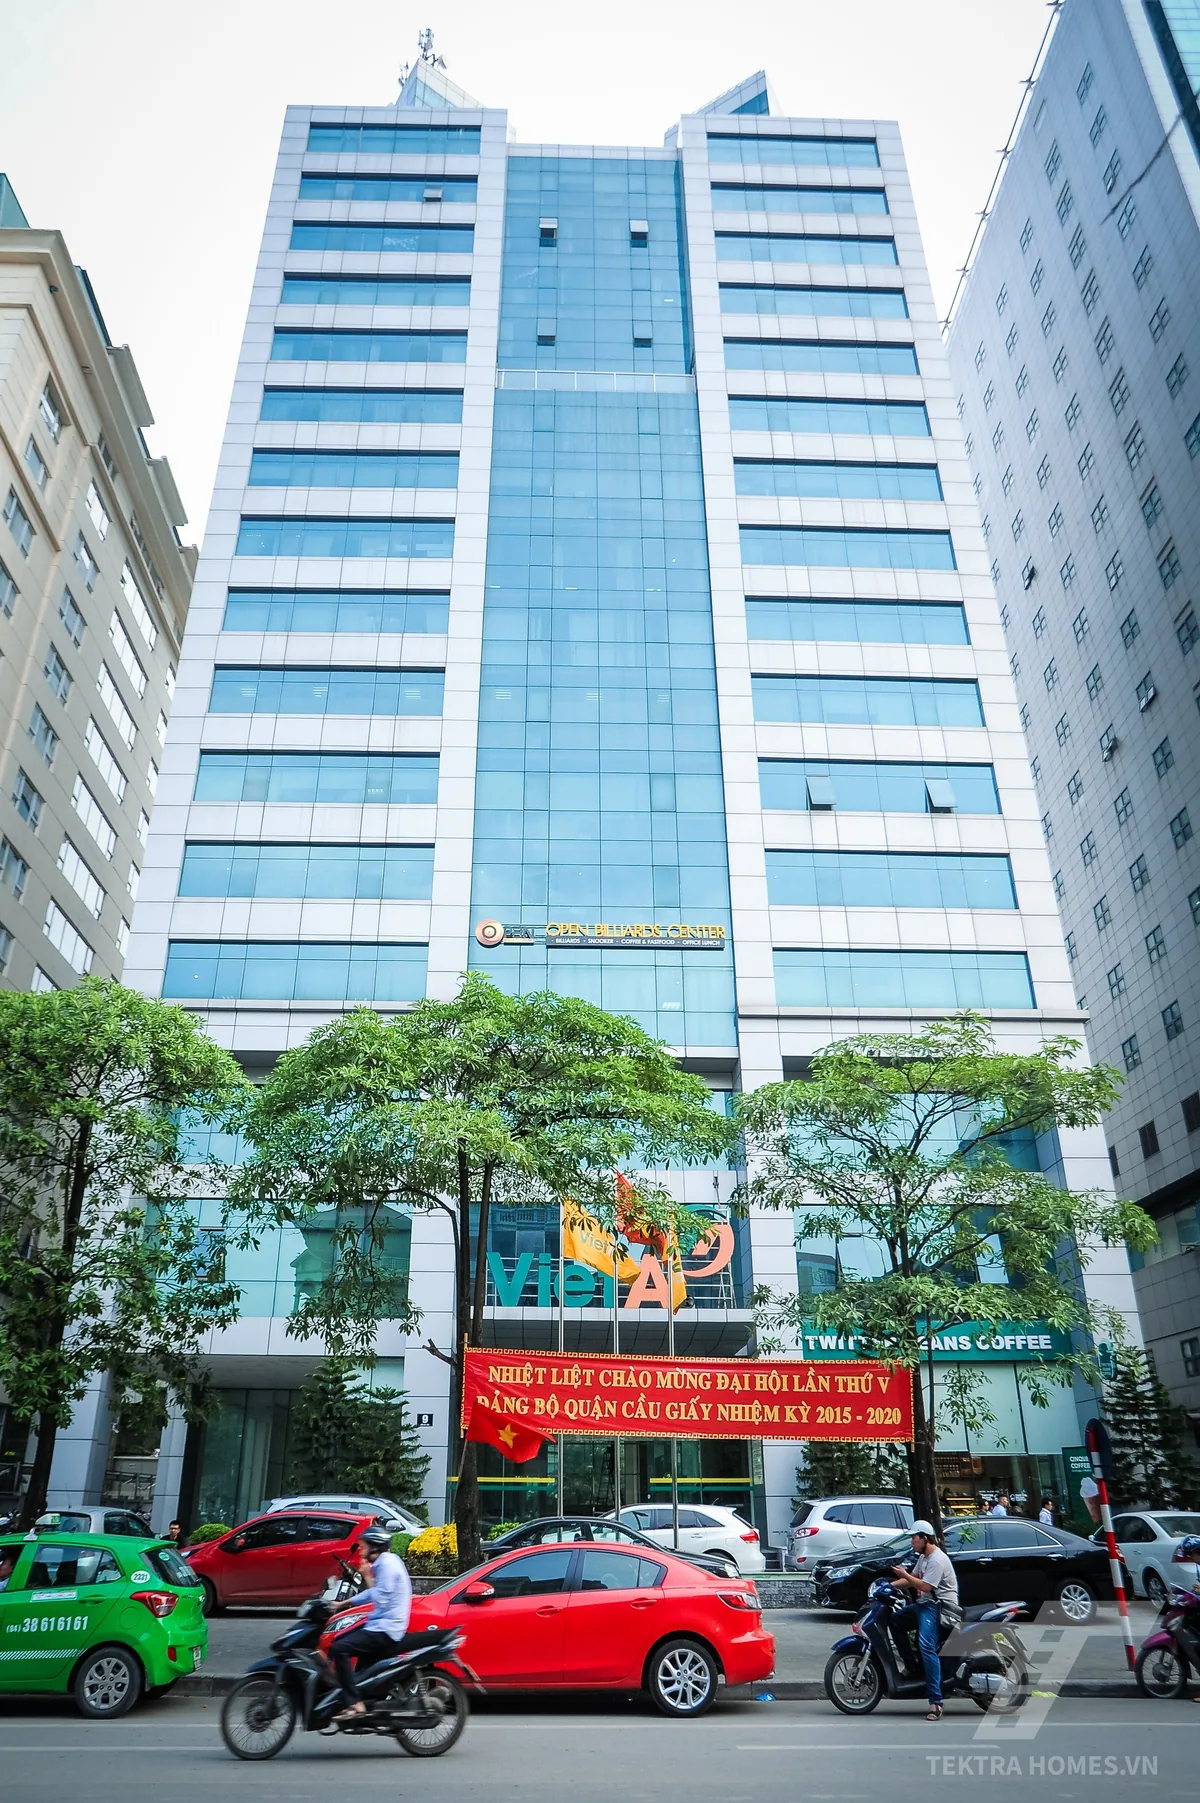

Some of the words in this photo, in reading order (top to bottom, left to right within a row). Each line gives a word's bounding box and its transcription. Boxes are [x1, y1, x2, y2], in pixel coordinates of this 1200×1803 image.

[546, 922, 589, 937] OPEN
[594, 923, 662, 938] BILLIARDS
[667, 924, 725, 939] CENTER
[914, 1335, 971, 1350] EANS
[976, 1335, 1052, 1350] COFFEE
[488, 1362, 546, 1387] NHIỆT
[550, 1364, 595, 1389] LIỆT
[599, 1365, 652, 1388] CHÀO
[656, 1367, 712, 1390] MỪNG
[716, 1372, 750, 1394] ĐẠI
[754, 1369, 789, 1395] HỘI
[793, 1366, 830, 1393] LẦN
[834, 1372, 873, 1394] THỨ
[877, 1376, 891, 1394] V
[533, 1393, 560, 1419] BỘ
[564, 1394, 617, 1421] QUẬN
[621, 1392, 662, 1419] CẦU
[665, 1395, 713, 1421] GIẤY
[717, 1399, 780, 1425] NHIỆM
[784, 1400, 813, 1423] KỲ
[815, 1406, 852, 1424] 2015
[866, 1407, 902, 1425] 2020
[422, 1414, 429, 1424] 9
